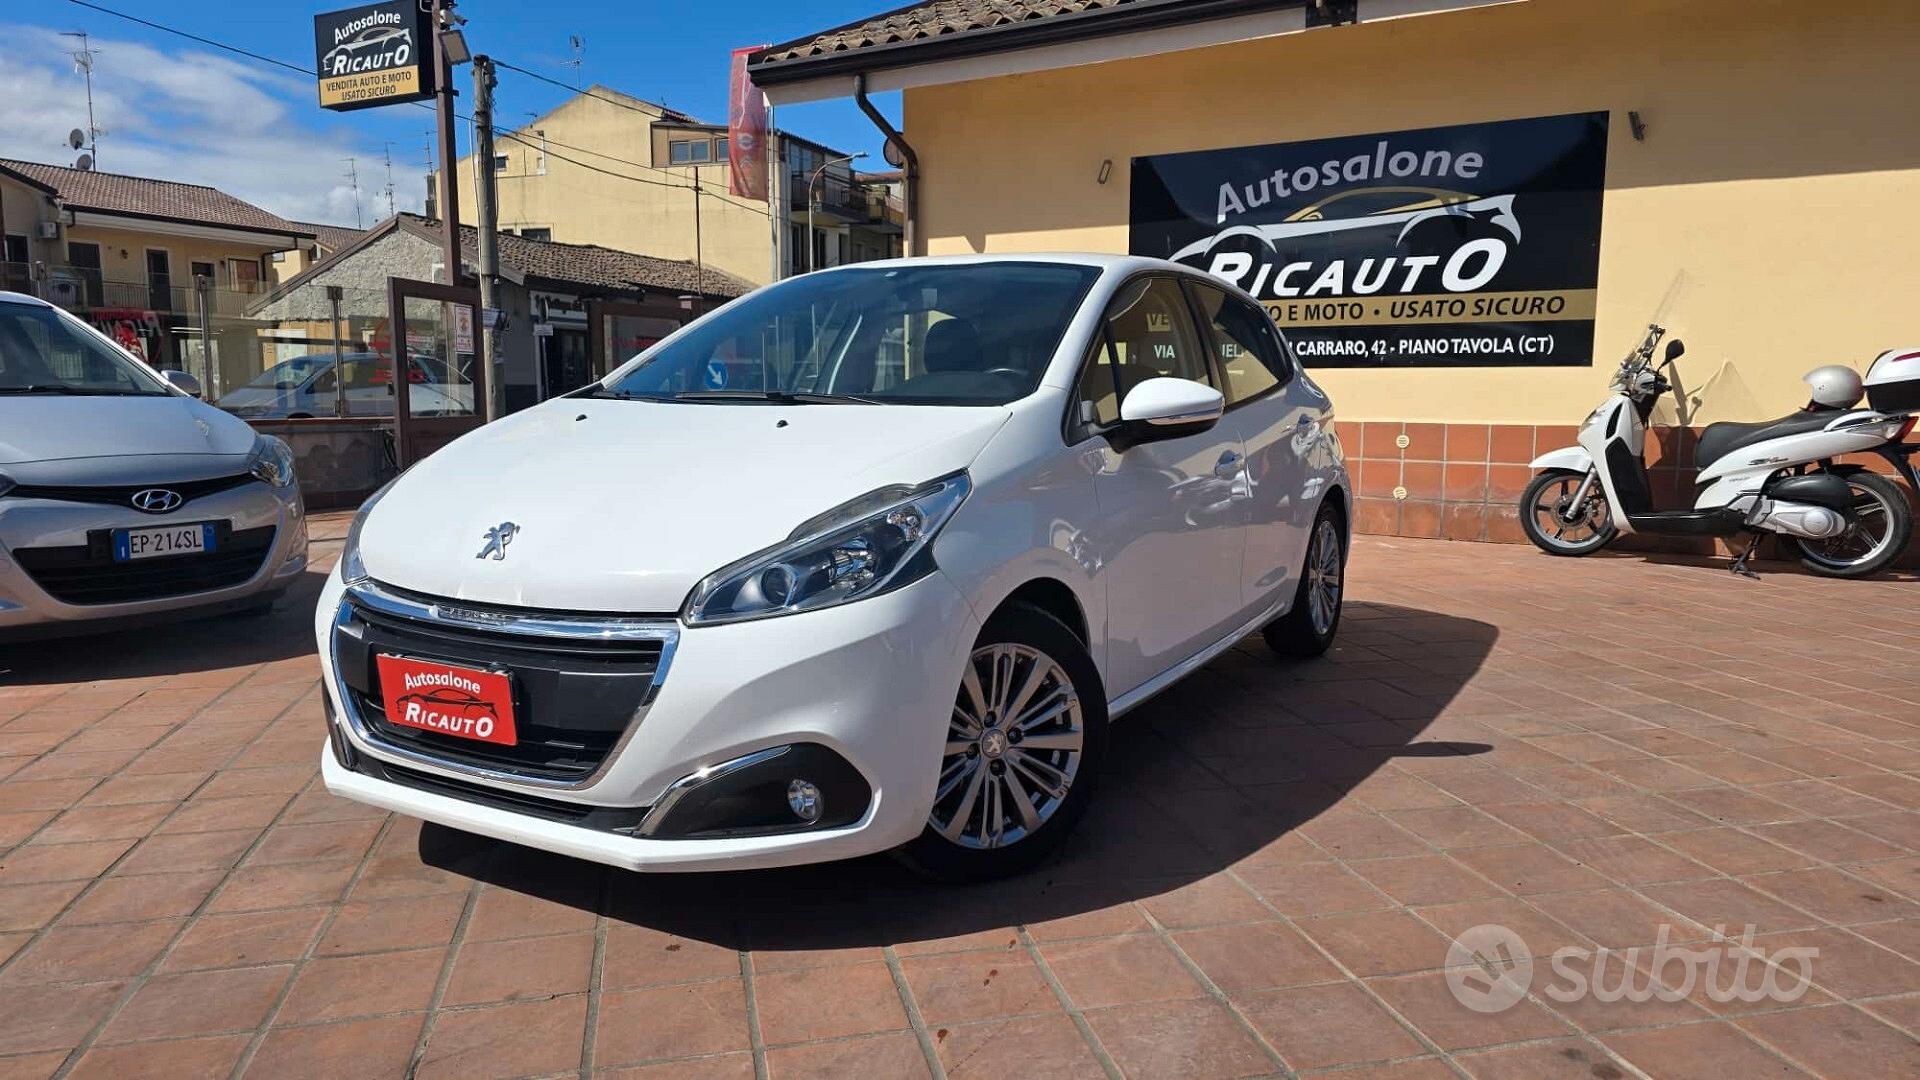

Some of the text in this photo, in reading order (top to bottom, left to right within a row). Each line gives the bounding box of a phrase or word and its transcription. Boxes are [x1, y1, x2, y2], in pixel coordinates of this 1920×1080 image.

[334, 10, 401, 45] Autosalone
[332, 44, 410, 75] RICAUTO
[326, 71, 412, 92] VENDITA AUTO E MOTO
[342, 84, 397, 101] USATO SICURO
[1217, 140, 1484, 225] Autosalone
[1288, 304, 1298, 321] E
[1304, 302, 1364, 321] MOTO
[1390, 299, 1466, 319] USATO
[1471, 295, 1565, 316] SICURO
[1153, 344, 1176, 359] VIA
[1296, 339, 1369, 357] CARRARO,
[1371, 339, 1387, 355] 42
[1399, 338, 1449, 355] PIANO
[1450, 337, 1515, 354] TAVOLA
[1518, 334, 1554, 355] (CT)
[130, 535, 149, 554] EP
[404, 670, 481, 694] Autosalone
[404, 702, 494, 738] RICAUTO
